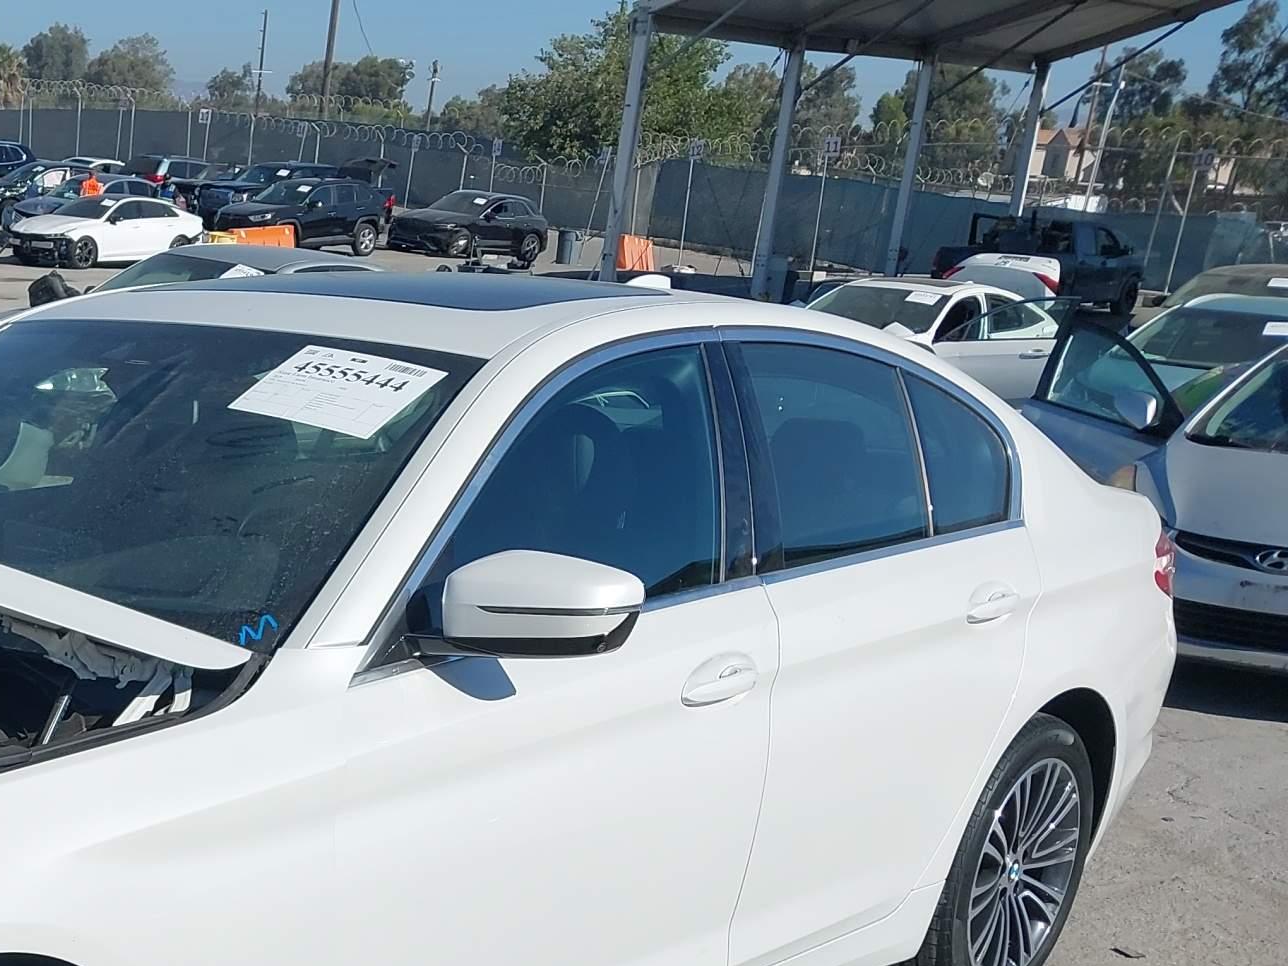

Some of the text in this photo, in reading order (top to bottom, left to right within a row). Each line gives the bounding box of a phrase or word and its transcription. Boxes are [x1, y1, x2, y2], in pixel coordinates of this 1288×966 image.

[691, 144, 703, 157] 12
[825, 141, 838, 153] 11
[293, 360, 410, 393] 45555444
